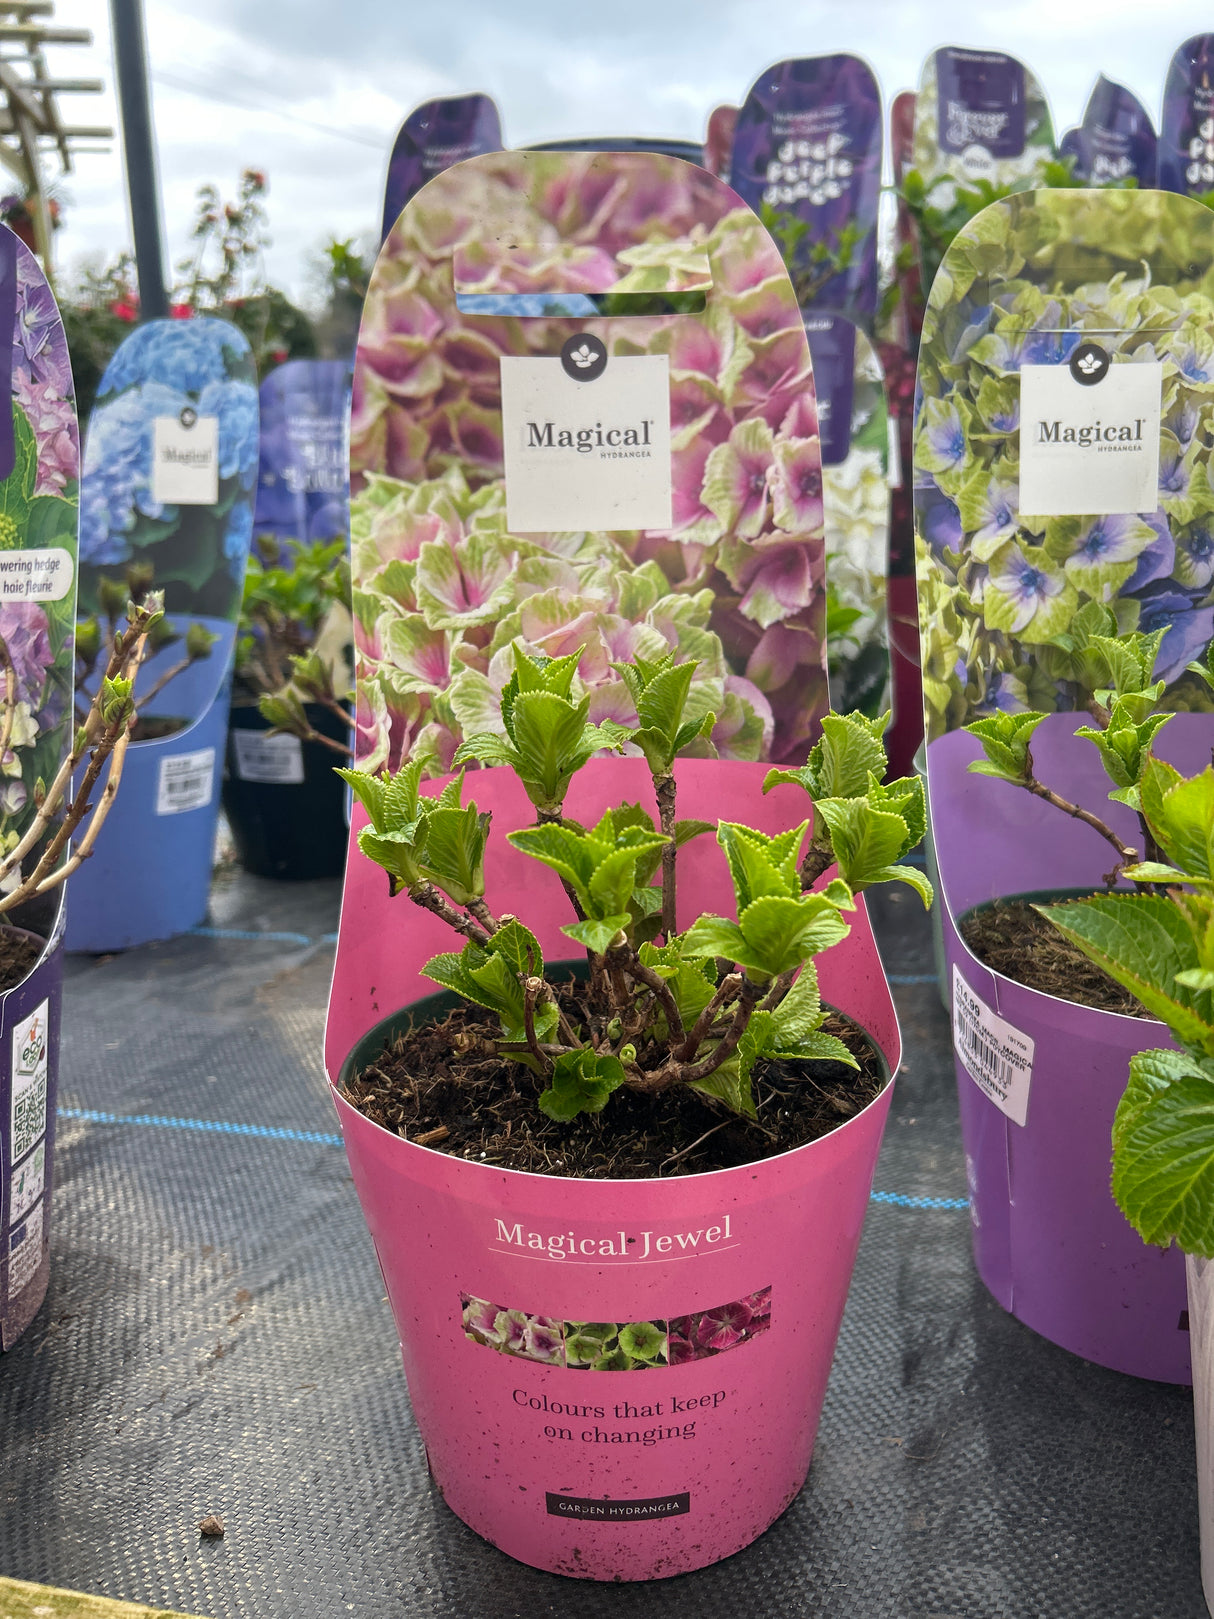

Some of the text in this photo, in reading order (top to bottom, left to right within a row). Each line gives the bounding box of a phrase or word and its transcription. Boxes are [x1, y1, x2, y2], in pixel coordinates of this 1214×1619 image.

[526, 420, 652, 453] Magical
[1038, 418, 1144, 448] Magical
[600, 451, 651, 459] HYDRANGEA
[1097, 445, 1142, 453] HYDRANGEA
[34, 557, 60, 574] hedge
[3, 577, 53, 596] haie fleurie
[22, 1035, 43, 1061] eco
[494, 1214, 733, 1260] Magical Jewel
[512, 1389, 726, 1418] Colours that keep
[544, 1420, 696, 1446] on changing
[609, 1502, 680, 1515] HYDRANGEA
